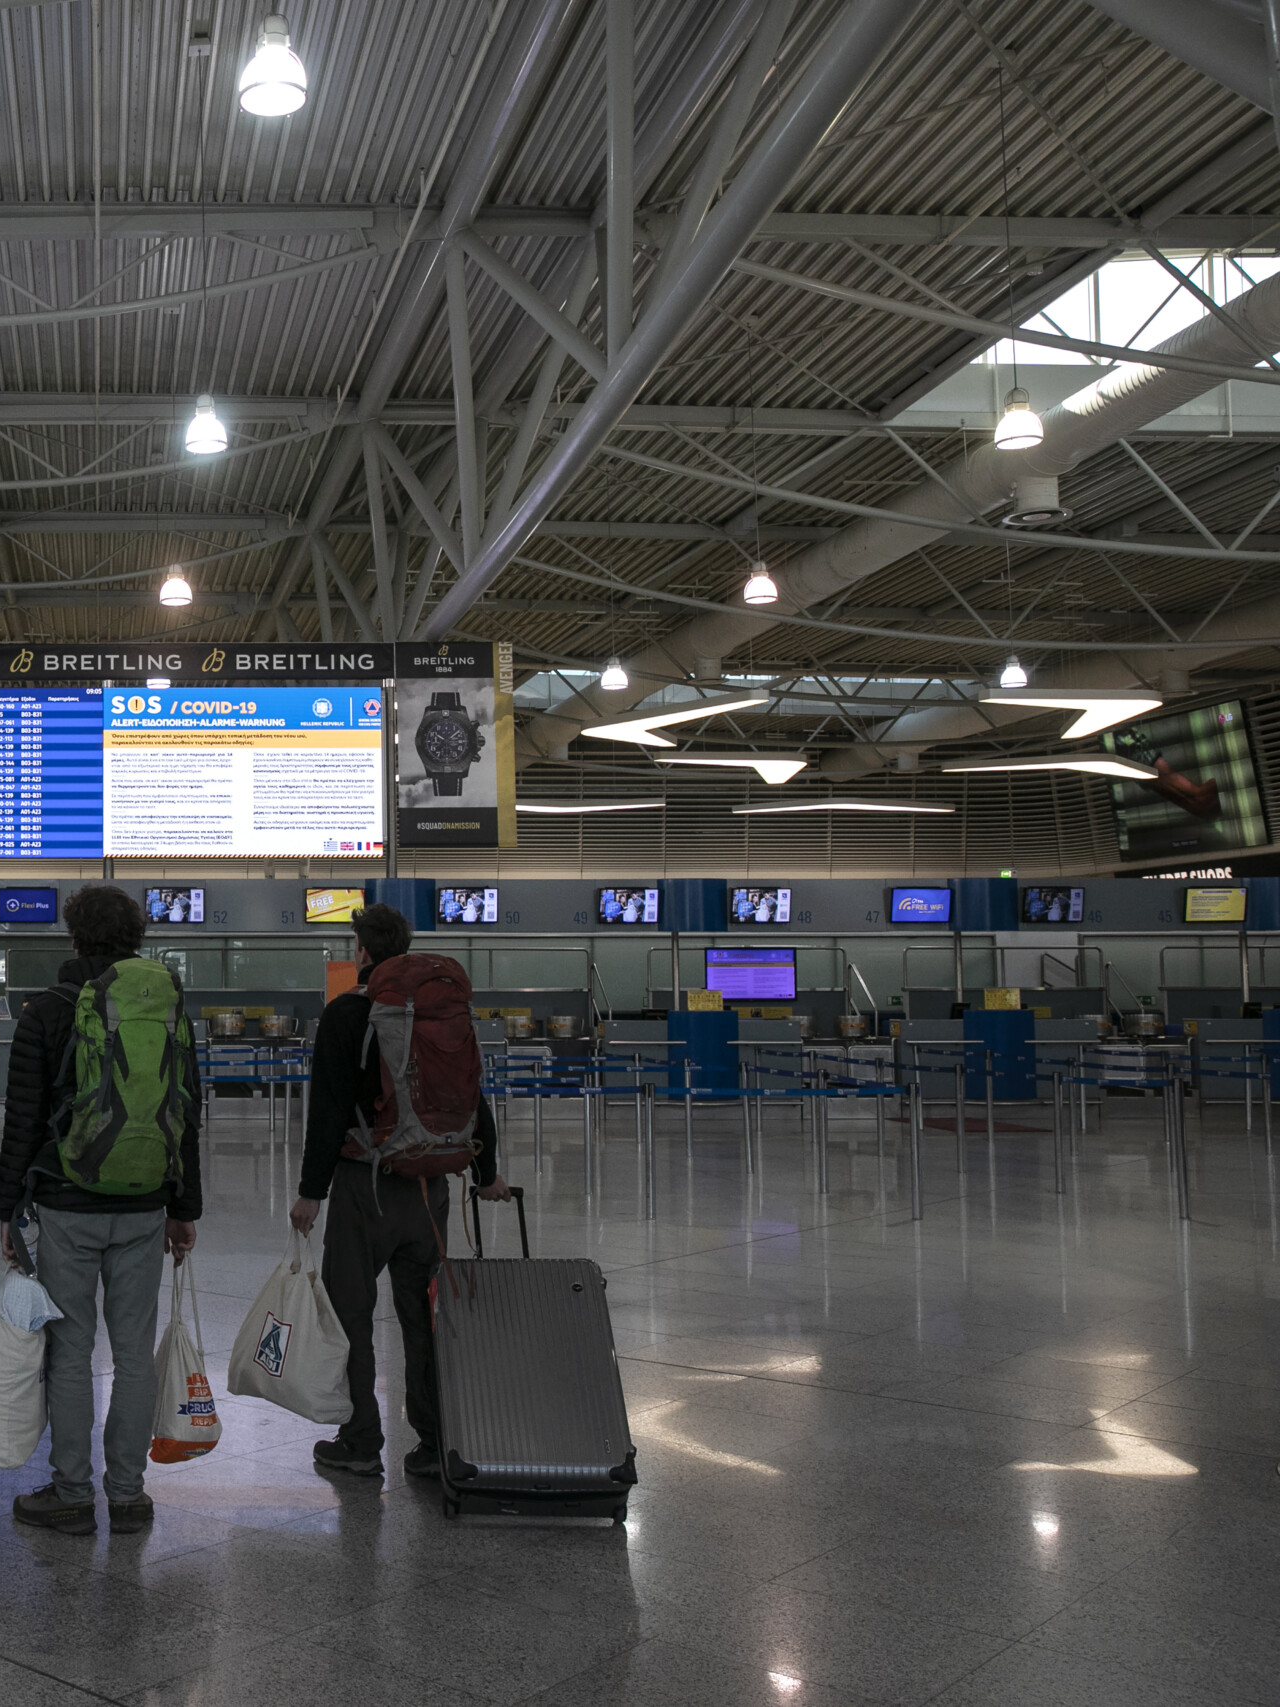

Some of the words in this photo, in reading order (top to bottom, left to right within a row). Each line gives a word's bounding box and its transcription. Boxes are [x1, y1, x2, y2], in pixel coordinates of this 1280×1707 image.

[43, 654, 182, 671] BREITLING
[235, 654, 375, 670] BREITLING
[414, 656, 475, 666] BREITLING
[180, 700, 257, 714] COVID-19
[1224, 713, 1233, 721] LG
[417, 822, 480, 830] #SQUADONAMISSION
[310, 895, 334, 909] FREE
[213, 911, 228, 924] 52
[281, 911, 295, 924] 51
[506, 911, 520, 924] 50
[573, 911, 588, 924] 49
[797, 911, 812, 924] 48
[866, 911, 879, 924] 47
